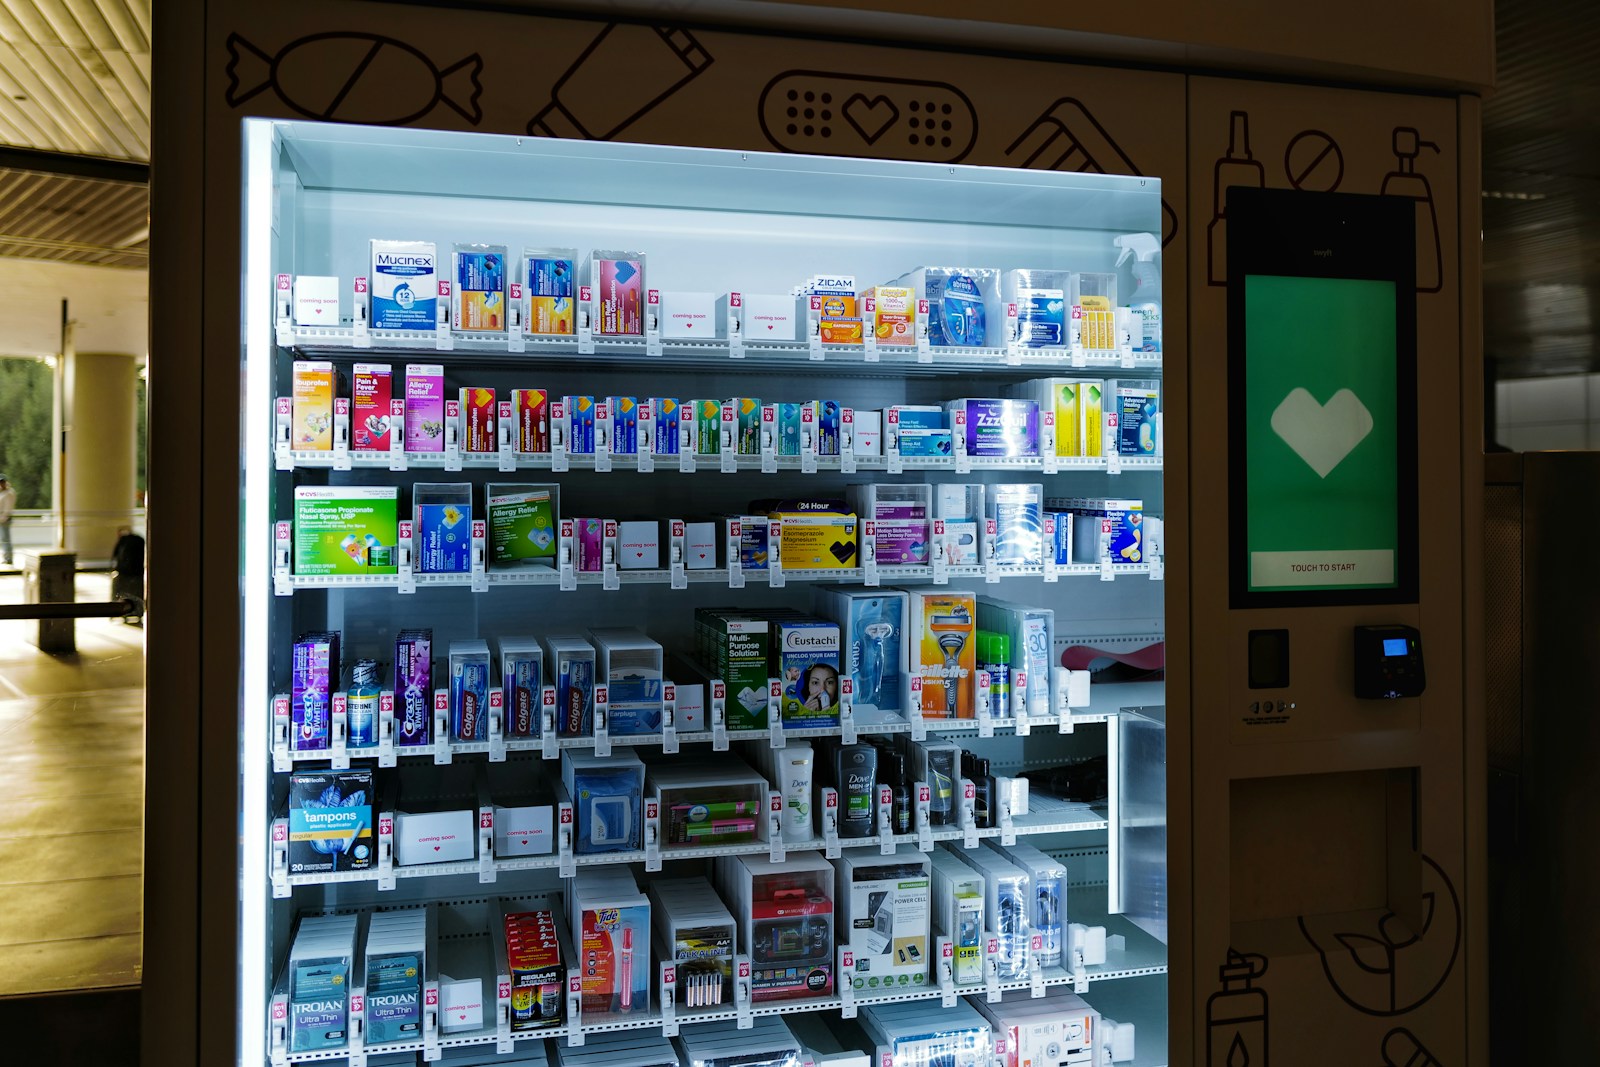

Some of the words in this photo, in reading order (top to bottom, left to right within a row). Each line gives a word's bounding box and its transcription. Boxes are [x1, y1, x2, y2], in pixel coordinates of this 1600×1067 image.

[378, 255, 431, 265] Mucinex
[493, 509, 516, 517] Allergy
[795, 636, 836, 645] Eustachi
[1030, 633, 1046, 652] 30
[302, 696, 313, 739] Crest
[404, 693, 414, 735] Crest
[463, 696, 474, 736] Colgate
[518, 691, 528, 732] Colgate
[570, 692, 579, 732] Colgate
[849, 774, 869, 783] Dove
[305, 812, 356, 823] tampons
[600, 910, 618, 922] Tide
[679, 949, 726, 958] ALKALINE
[370, 993, 417, 1006] TROJAN
[294, 1000, 343, 1013] TROJAN
